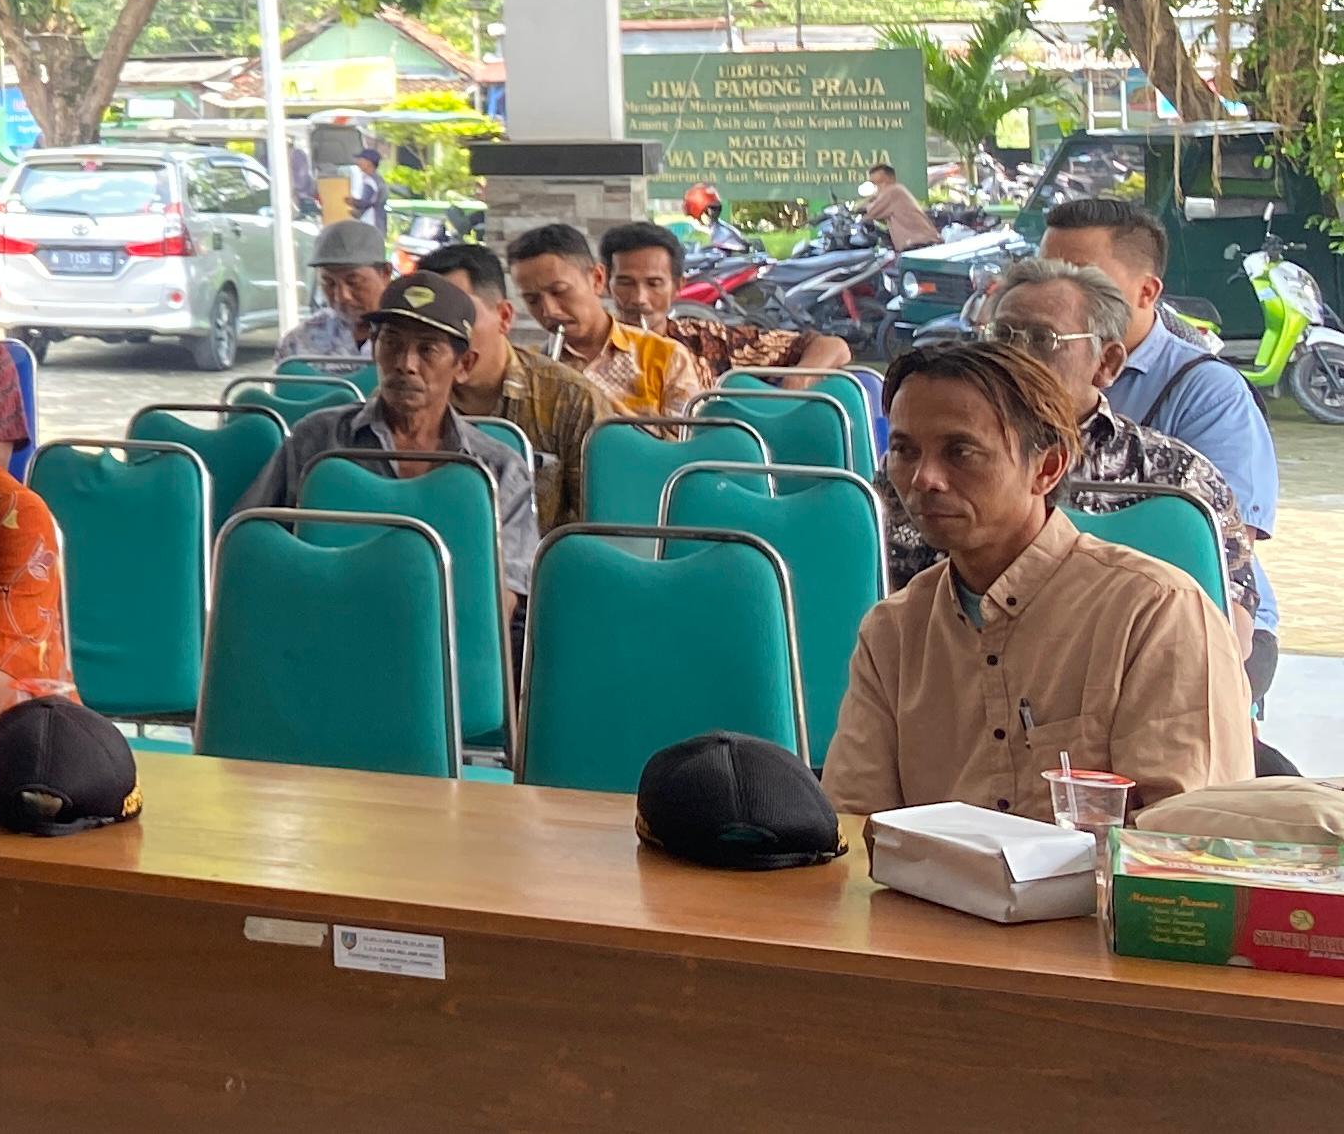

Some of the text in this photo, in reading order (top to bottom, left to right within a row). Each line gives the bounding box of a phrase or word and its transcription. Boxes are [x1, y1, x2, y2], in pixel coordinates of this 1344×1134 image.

[646, 77, 886, 99] JIWA PAMONG PRAJA
[727, 135, 806, 148] MATIKAN
[665, 149, 892, 168] WA PANGREH PRAJA
